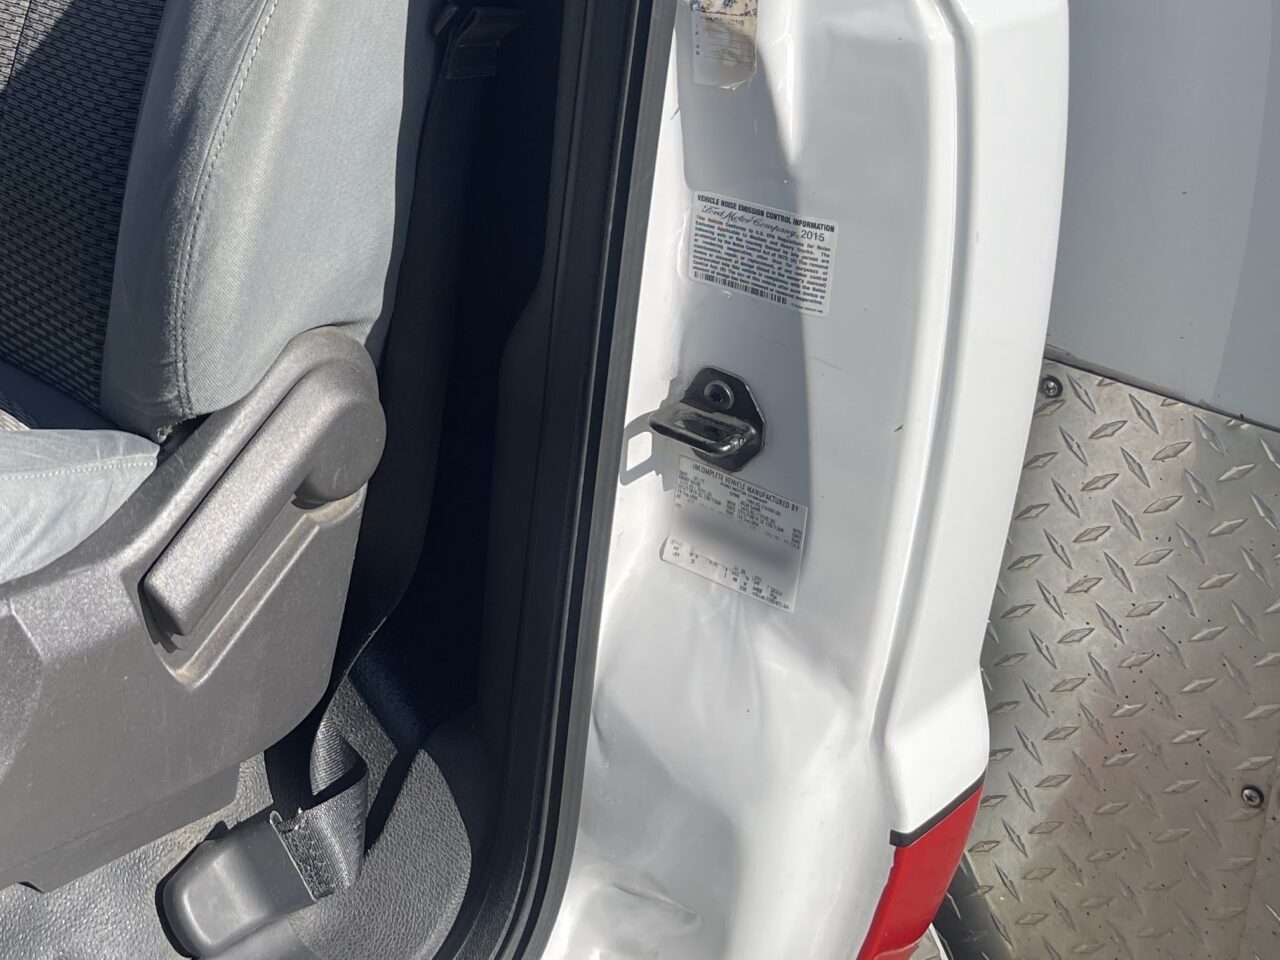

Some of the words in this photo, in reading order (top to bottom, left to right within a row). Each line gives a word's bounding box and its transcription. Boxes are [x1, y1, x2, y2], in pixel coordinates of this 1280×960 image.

[698, 194, 719, 205] VEHICLE
[721, 200, 736, 210] NOISE
[738, 204, 765, 217] EMISSION
[766, 211, 791, 224] CONTROL
[793, 217, 835, 233] INFORMATION
[702, 204, 723, 217] Ford
[721, 210, 751, 225] Motor
[800, 229, 825, 243] 2015
[692, 463, 724, 482] INCOMPLETE
[725, 477, 746, 490] VEHICLE
[747, 486, 790, 509] MANUFACTURED
[791, 504, 799, 513] BY
